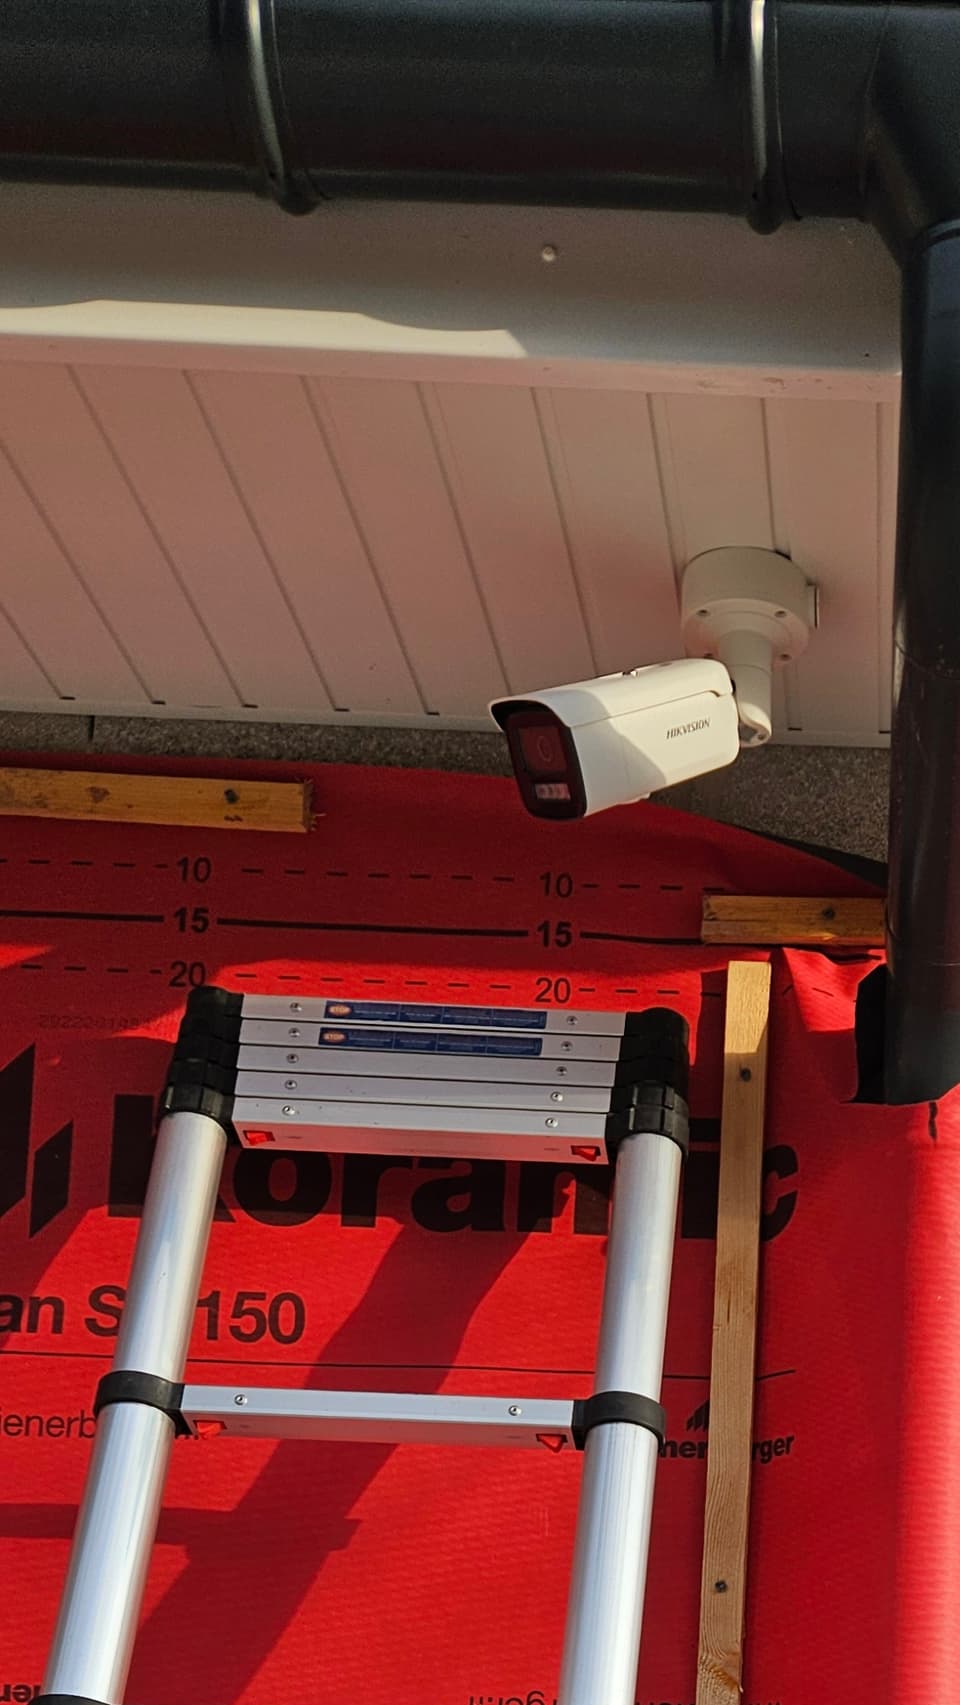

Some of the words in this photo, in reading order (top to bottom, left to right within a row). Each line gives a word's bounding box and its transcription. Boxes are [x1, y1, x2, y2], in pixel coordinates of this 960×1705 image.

[666, 717, 710, 740] HIKVISION
[177, 857, 211, 883] 10
[540, 872, 573, 898] 10
[174, 907, 209, 933] 15
[537, 921, 572, 948] 15
[169, 961, 206, 988] 20
[535, 977, 571, 1004] 20
[197, 1290, 306, 1345] 150
